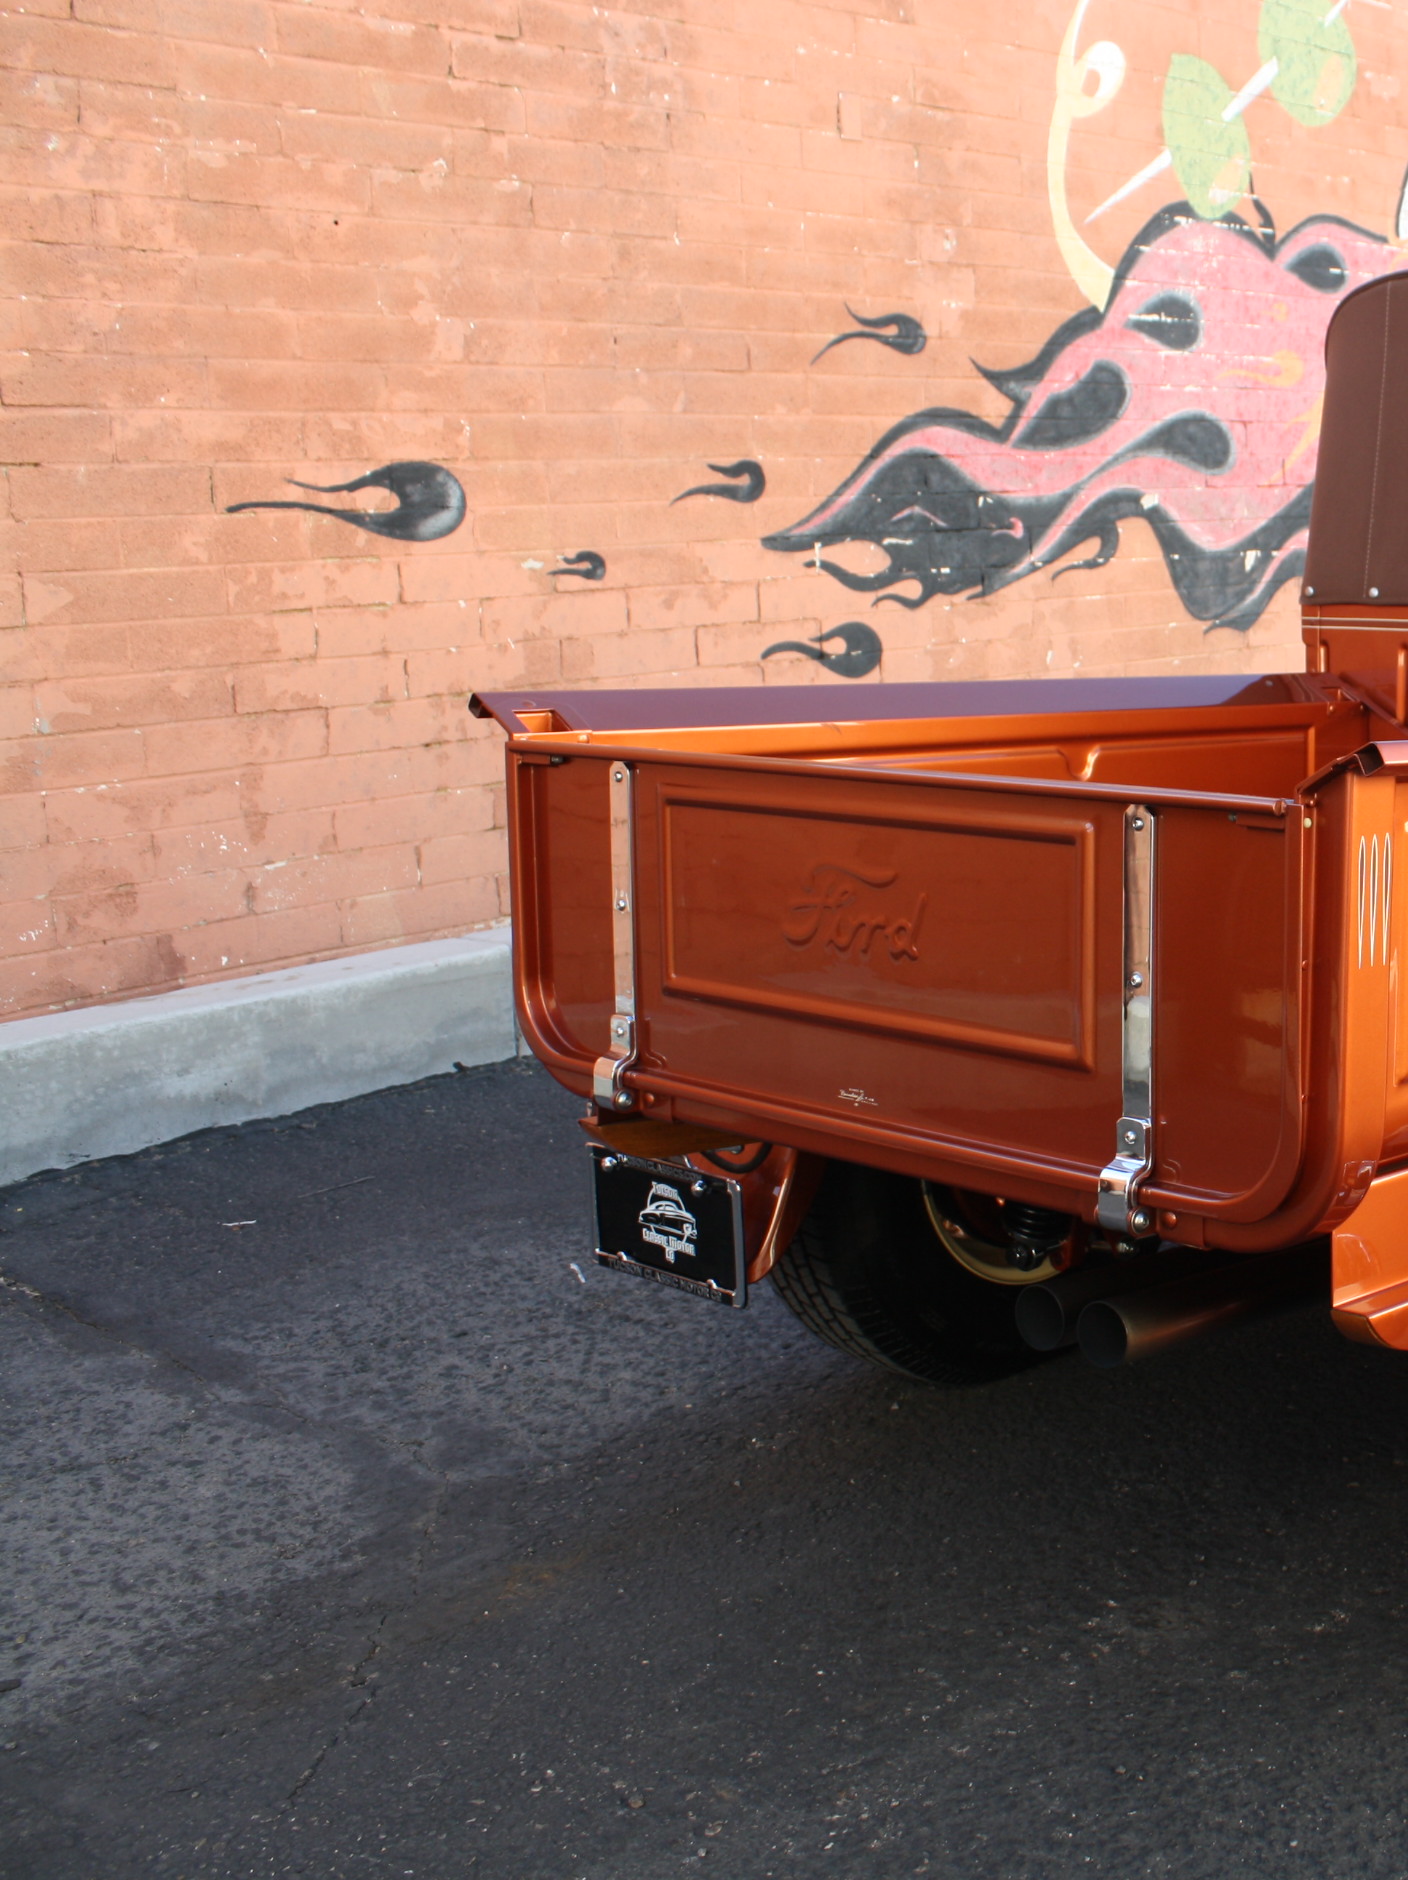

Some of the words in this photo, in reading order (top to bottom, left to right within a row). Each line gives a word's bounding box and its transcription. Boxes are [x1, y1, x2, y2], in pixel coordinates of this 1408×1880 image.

[782, 863, 928, 963] Ford
[607, 1258, 642, 1276] TUCSON
[643, 1268, 679, 1288] CLASSIC
[679, 1280, 710, 1298] MOTOR
